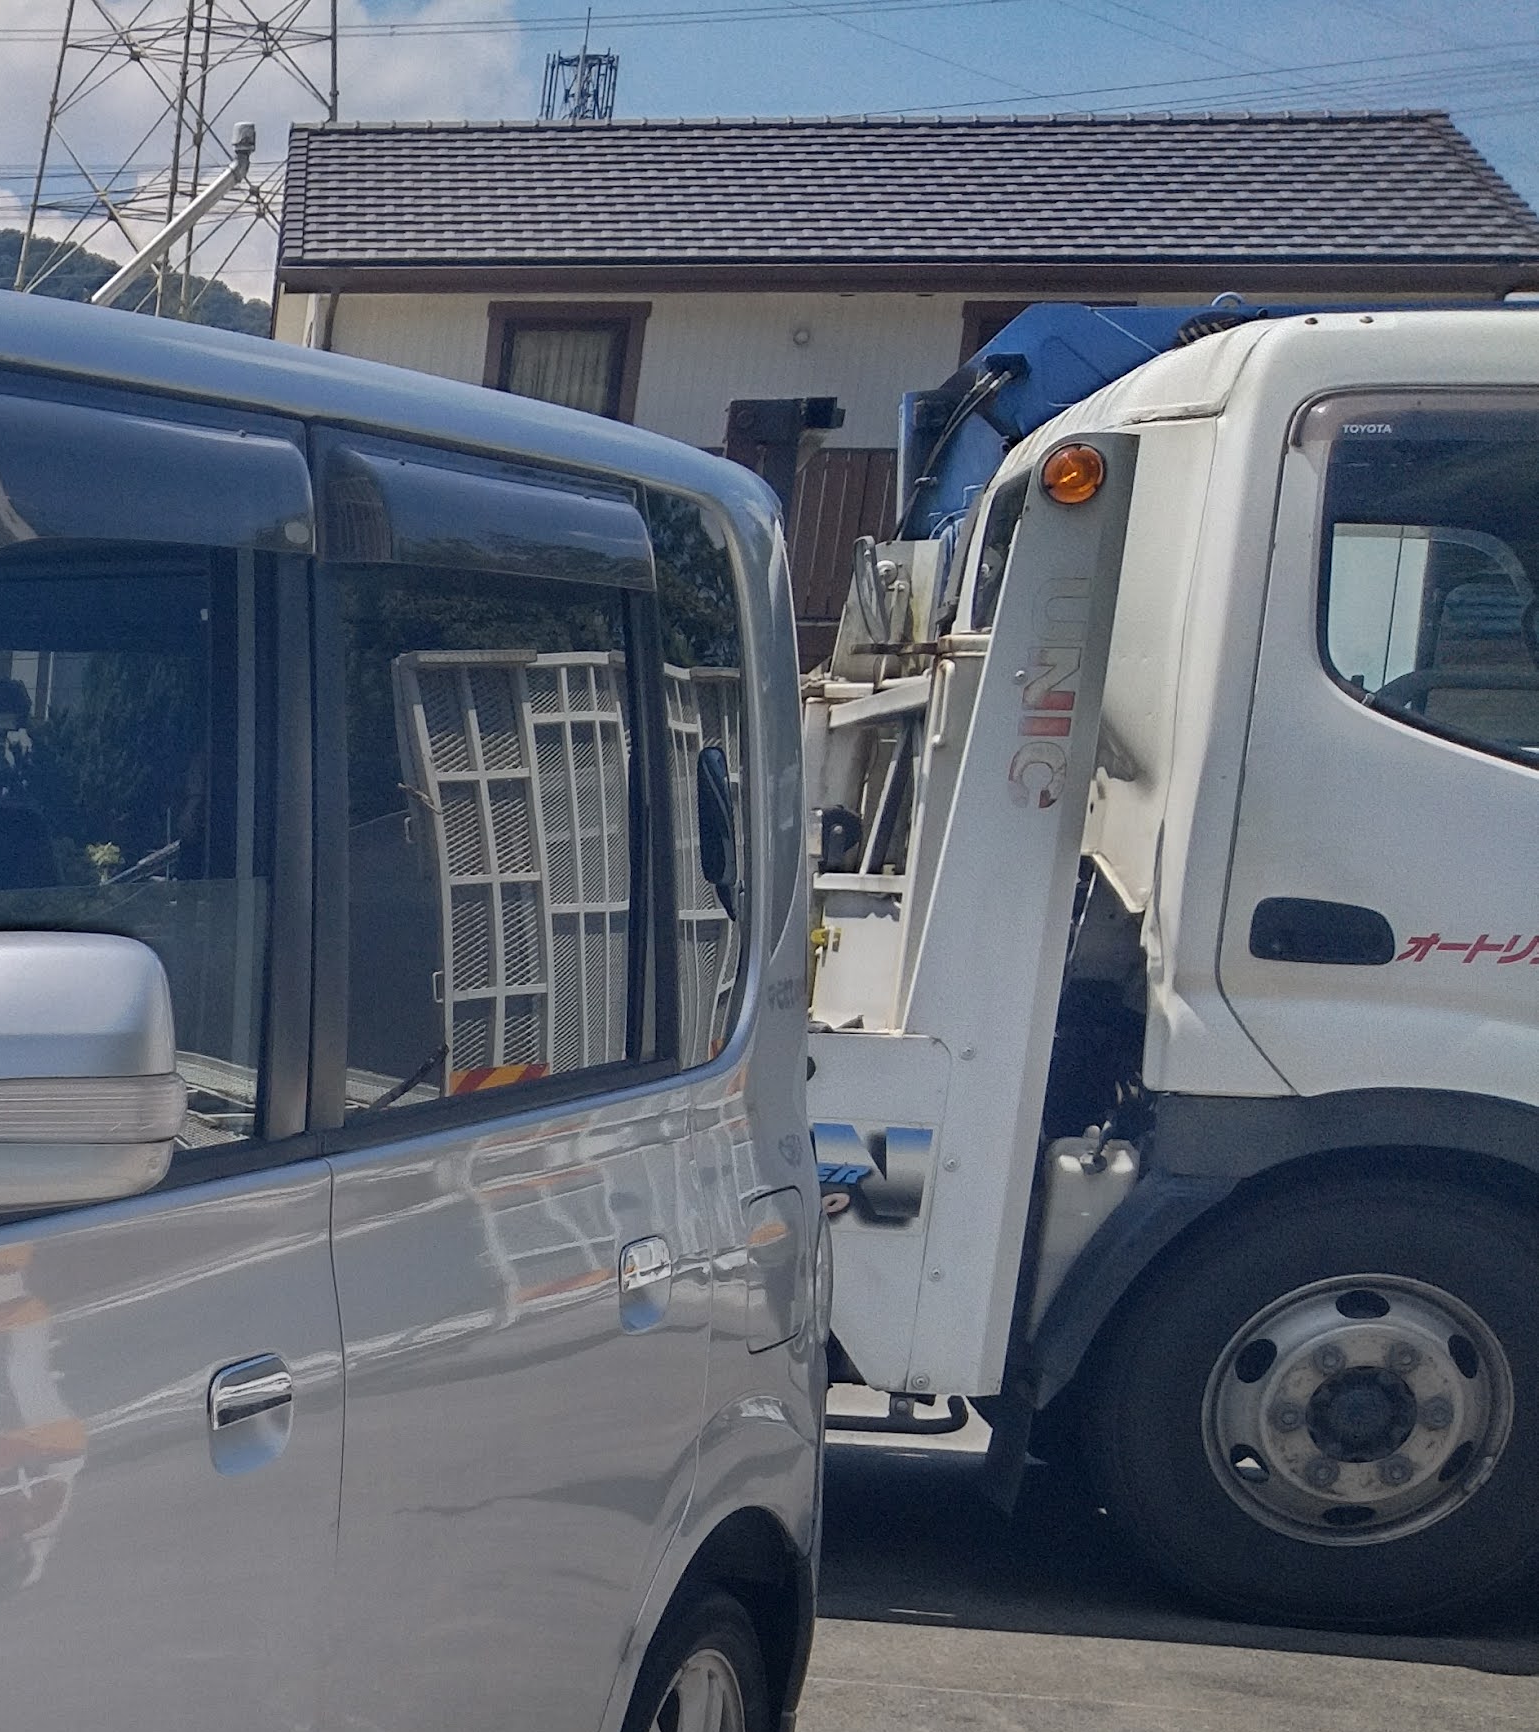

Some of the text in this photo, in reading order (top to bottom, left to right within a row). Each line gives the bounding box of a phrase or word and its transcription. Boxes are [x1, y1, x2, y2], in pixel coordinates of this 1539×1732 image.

[1343, 424, 1393, 434] TOYOTA
[1008, 577, 1092, 809] UNIC
[1395, 932, 1539, 964] オートリ
